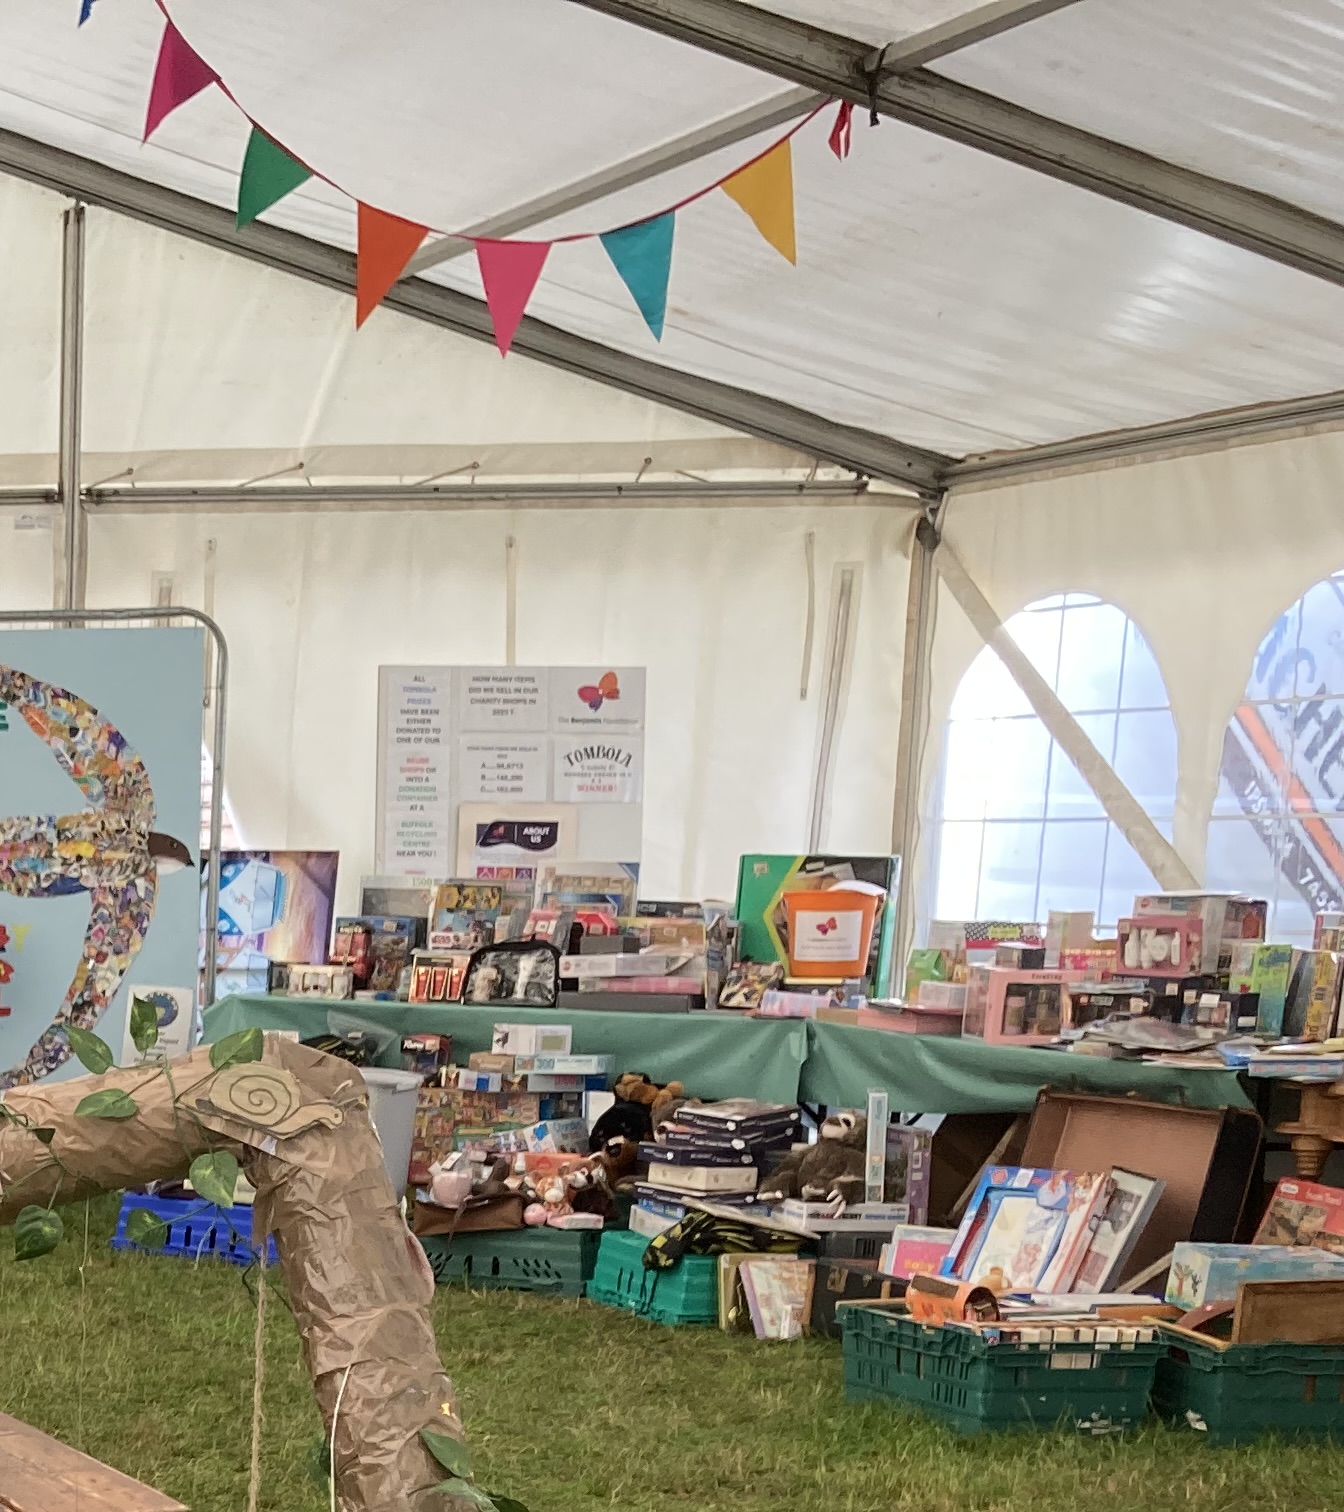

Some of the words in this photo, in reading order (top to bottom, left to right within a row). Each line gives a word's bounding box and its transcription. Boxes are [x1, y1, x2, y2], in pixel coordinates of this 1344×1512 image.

[571, 717, 602, 725] Benjamin
[563, 744, 633, 768] TOMBOLA
[522, 826, 550, 836] ABOUT
[530, 835, 542, 844] US
